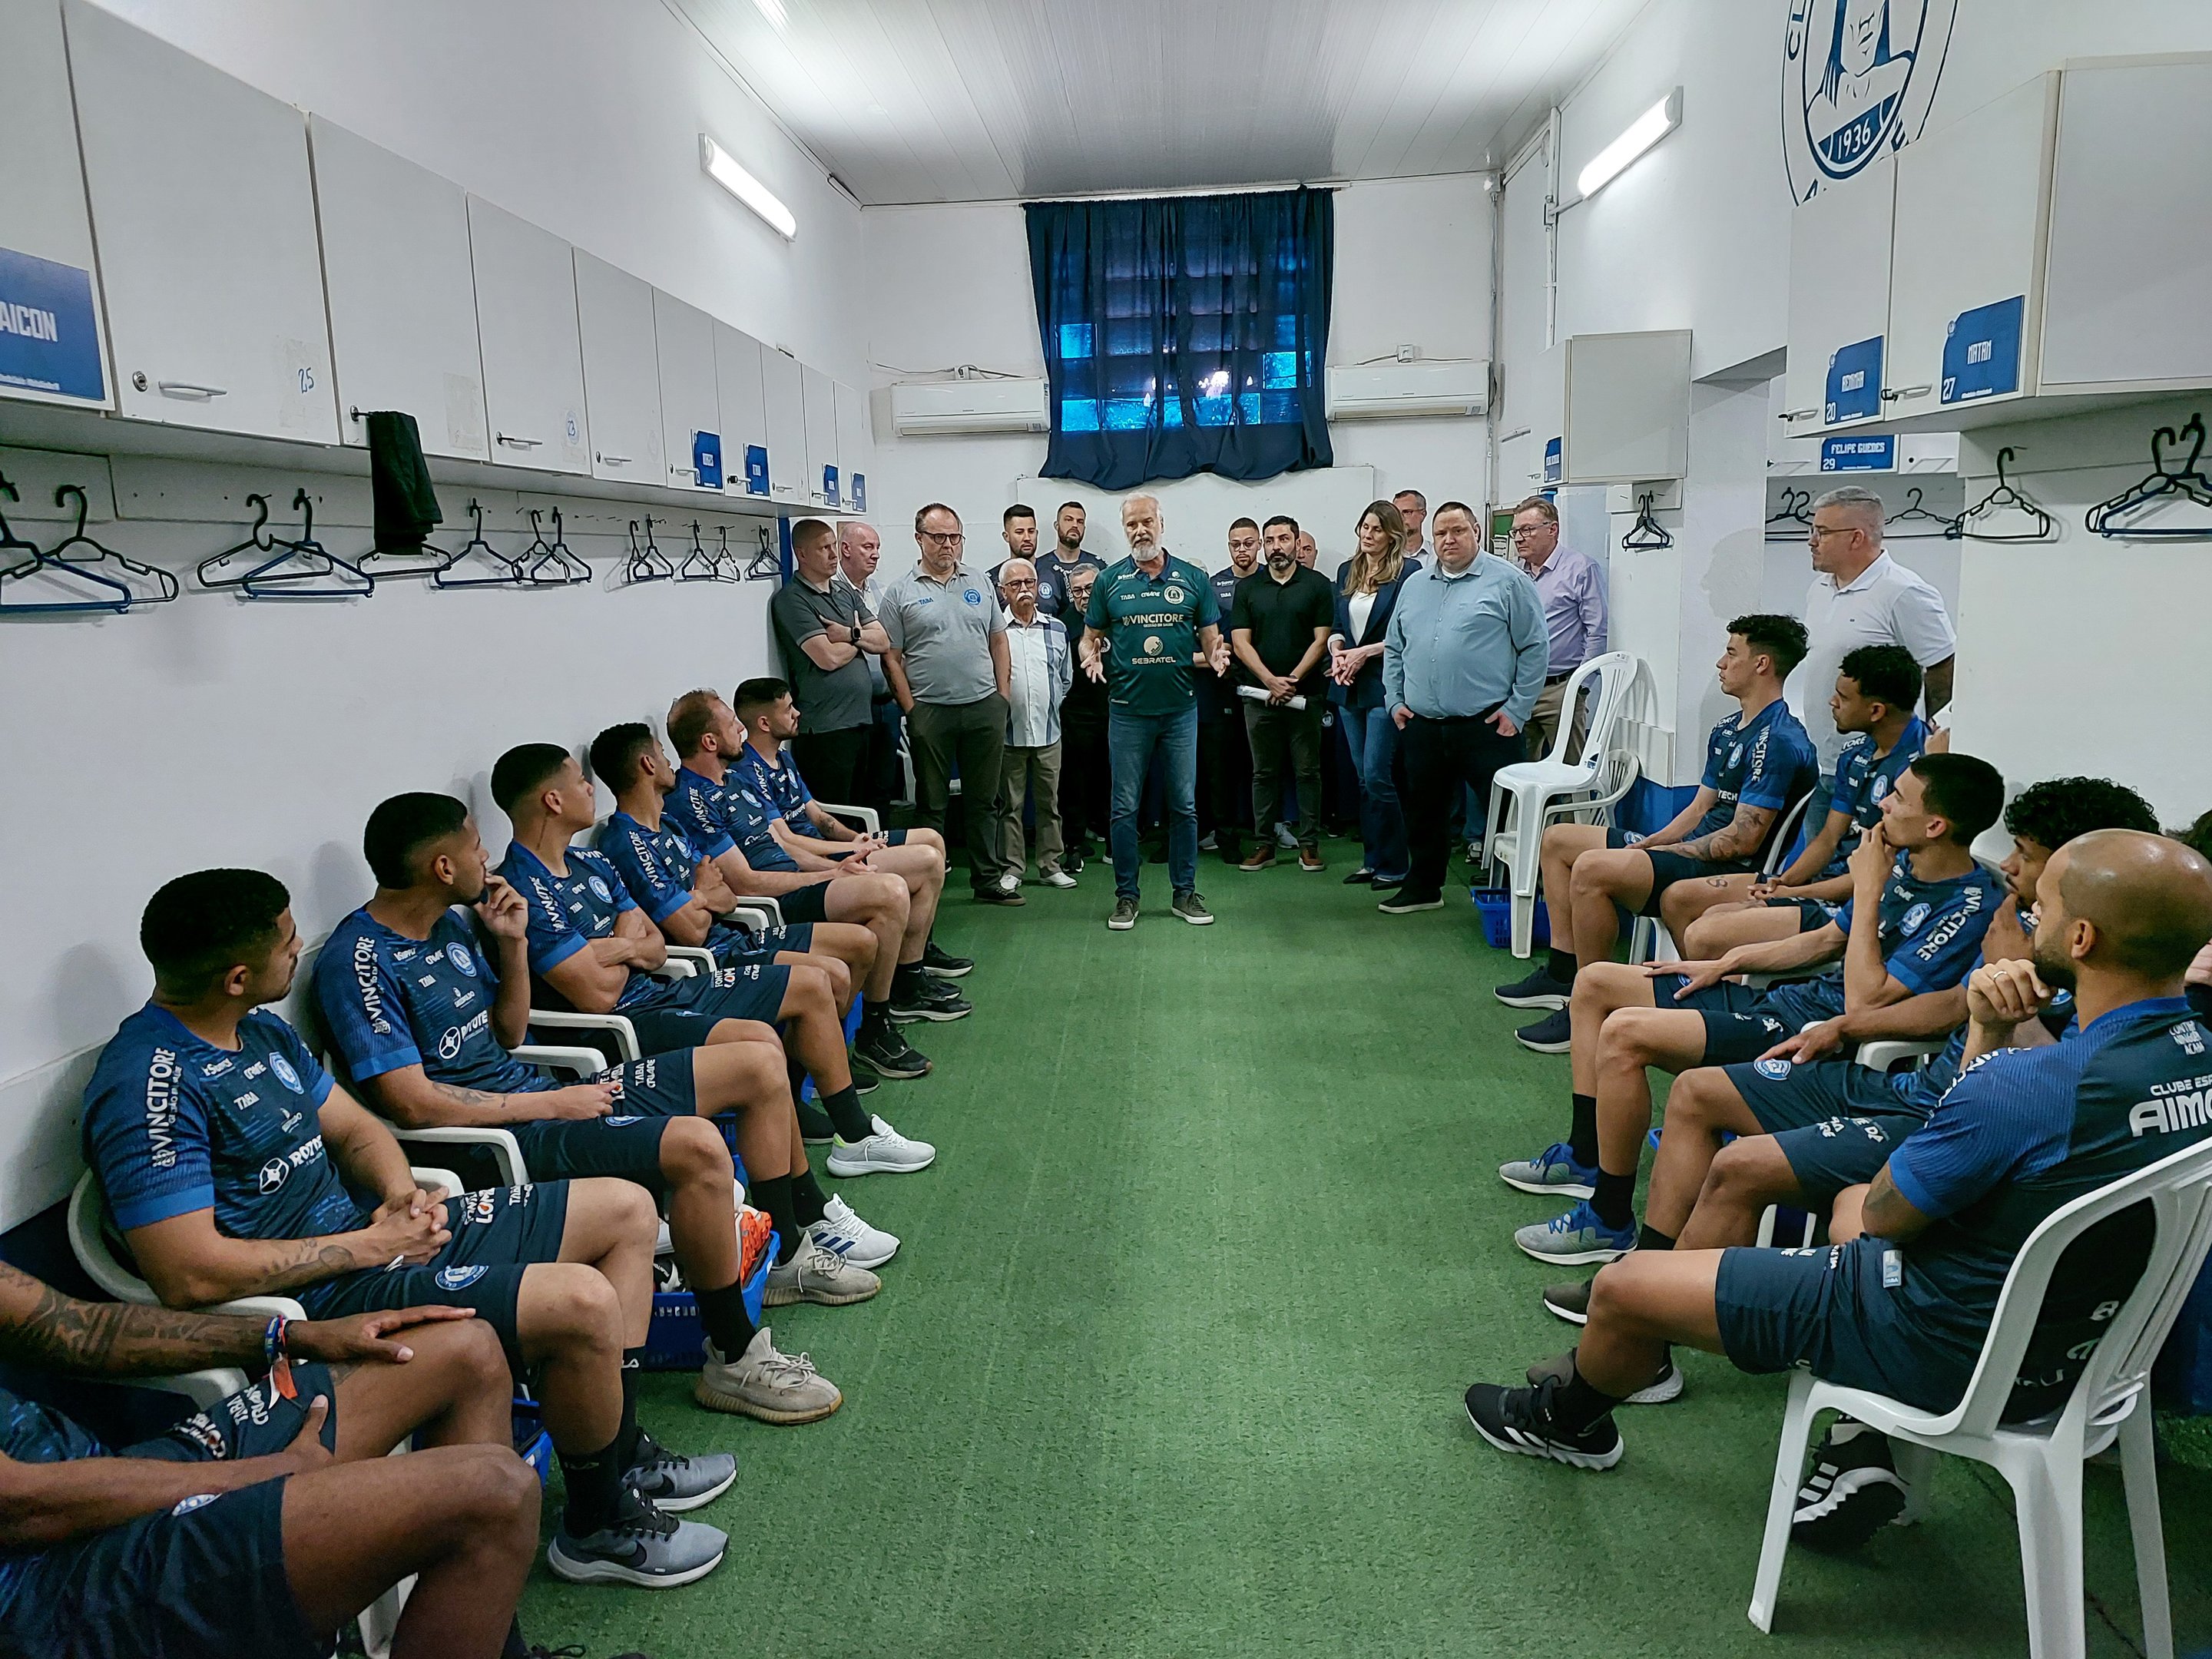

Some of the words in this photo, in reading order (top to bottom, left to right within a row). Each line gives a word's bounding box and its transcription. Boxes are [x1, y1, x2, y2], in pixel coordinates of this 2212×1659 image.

[1836, 117, 1871, 161] 1936
[0, 300, 58, 343] AICON
[298, 367, 314, 394] 25
[1942, 376, 1956, 401] 27
[1826, 402, 1836, 422] 20
[1831, 443, 1856, 455] FELIPE
[1823, 458, 1836, 470] 29
[918, 597, 934, 605] TABA
[1129, 614, 1184, 624] VINCITORE
[354, 936, 382, 1020] VINCITORE
[635, 1063, 644, 1087] TABA
[2151, 1079, 2193, 1096] CLUBE
[146, 1048, 176, 1151] VINCITORE
[233, 1091, 260, 1111] TABA
